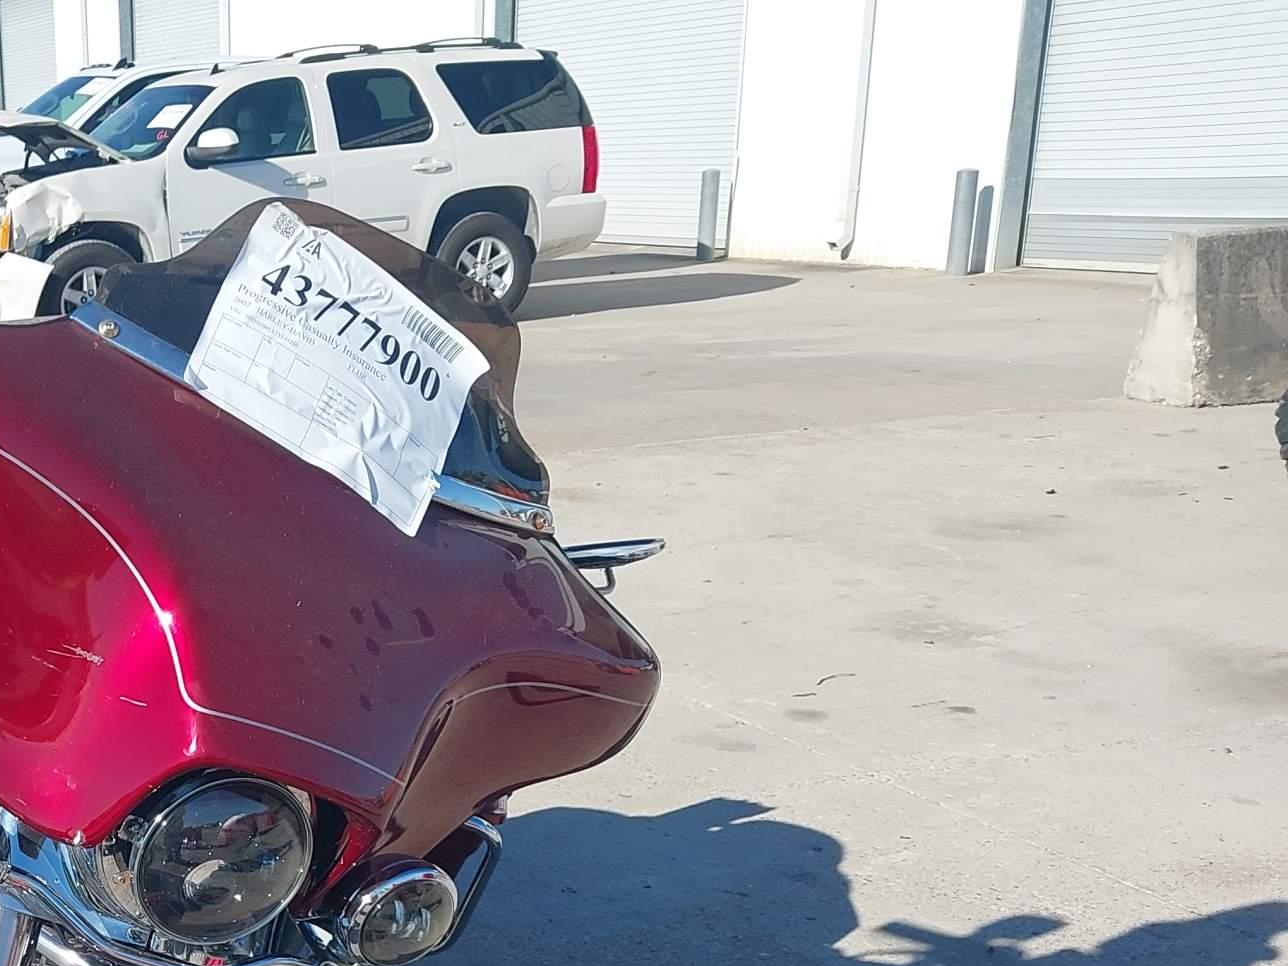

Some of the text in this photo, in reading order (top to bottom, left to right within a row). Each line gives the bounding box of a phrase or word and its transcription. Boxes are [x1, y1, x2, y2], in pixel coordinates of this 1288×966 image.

[156, 129, 169, 140] GL
[238, 283, 297, 322] Progressive
[298, 315, 341, 350] Casualty
[341, 344, 388, 382] Insurance
[257, 306, 316, 346] HARLEY-DAVID
[261, 264, 441, 402] 43777900
